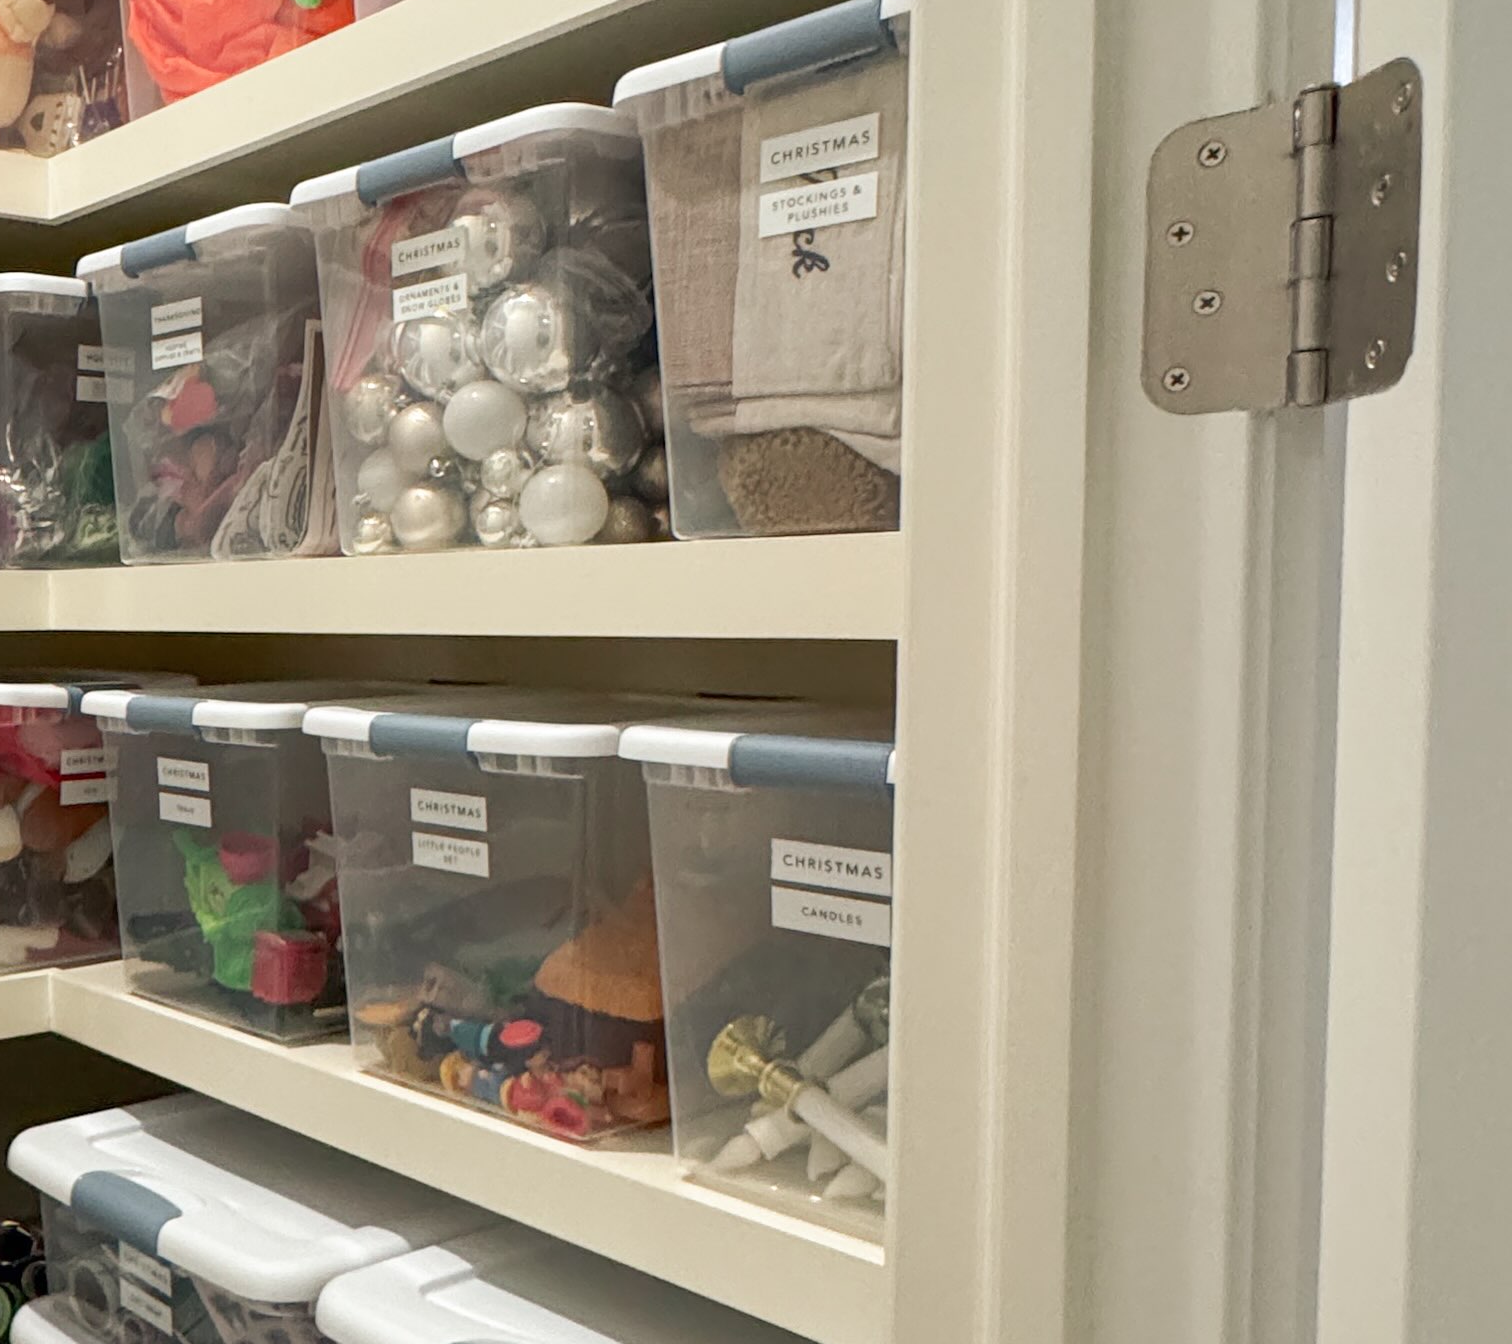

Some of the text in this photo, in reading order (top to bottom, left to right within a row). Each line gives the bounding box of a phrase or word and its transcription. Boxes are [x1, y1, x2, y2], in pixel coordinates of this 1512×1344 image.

[769, 129, 871, 166] CHRISTMAS
[771, 184, 863, 212] STOCKINGS &
[786, 201, 850, 225] PLUSHIES
[397, 236, 461, 264] CHRISTMAS
[398, 284, 450, 303] ORNAMENTS
[400, 294, 461, 314] SNOW GLOBES
[65, 754, 105, 768] CHRISTM
[161, 766, 206, 781] CHRISTMAS
[416, 799, 482, 820] CHRISTMAS
[417, 838, 481, 858] LITTLE PEOPLE
[782, 853, 884, 881] CHRISTMAS
[800, 906, 863, 927] CANDLES
